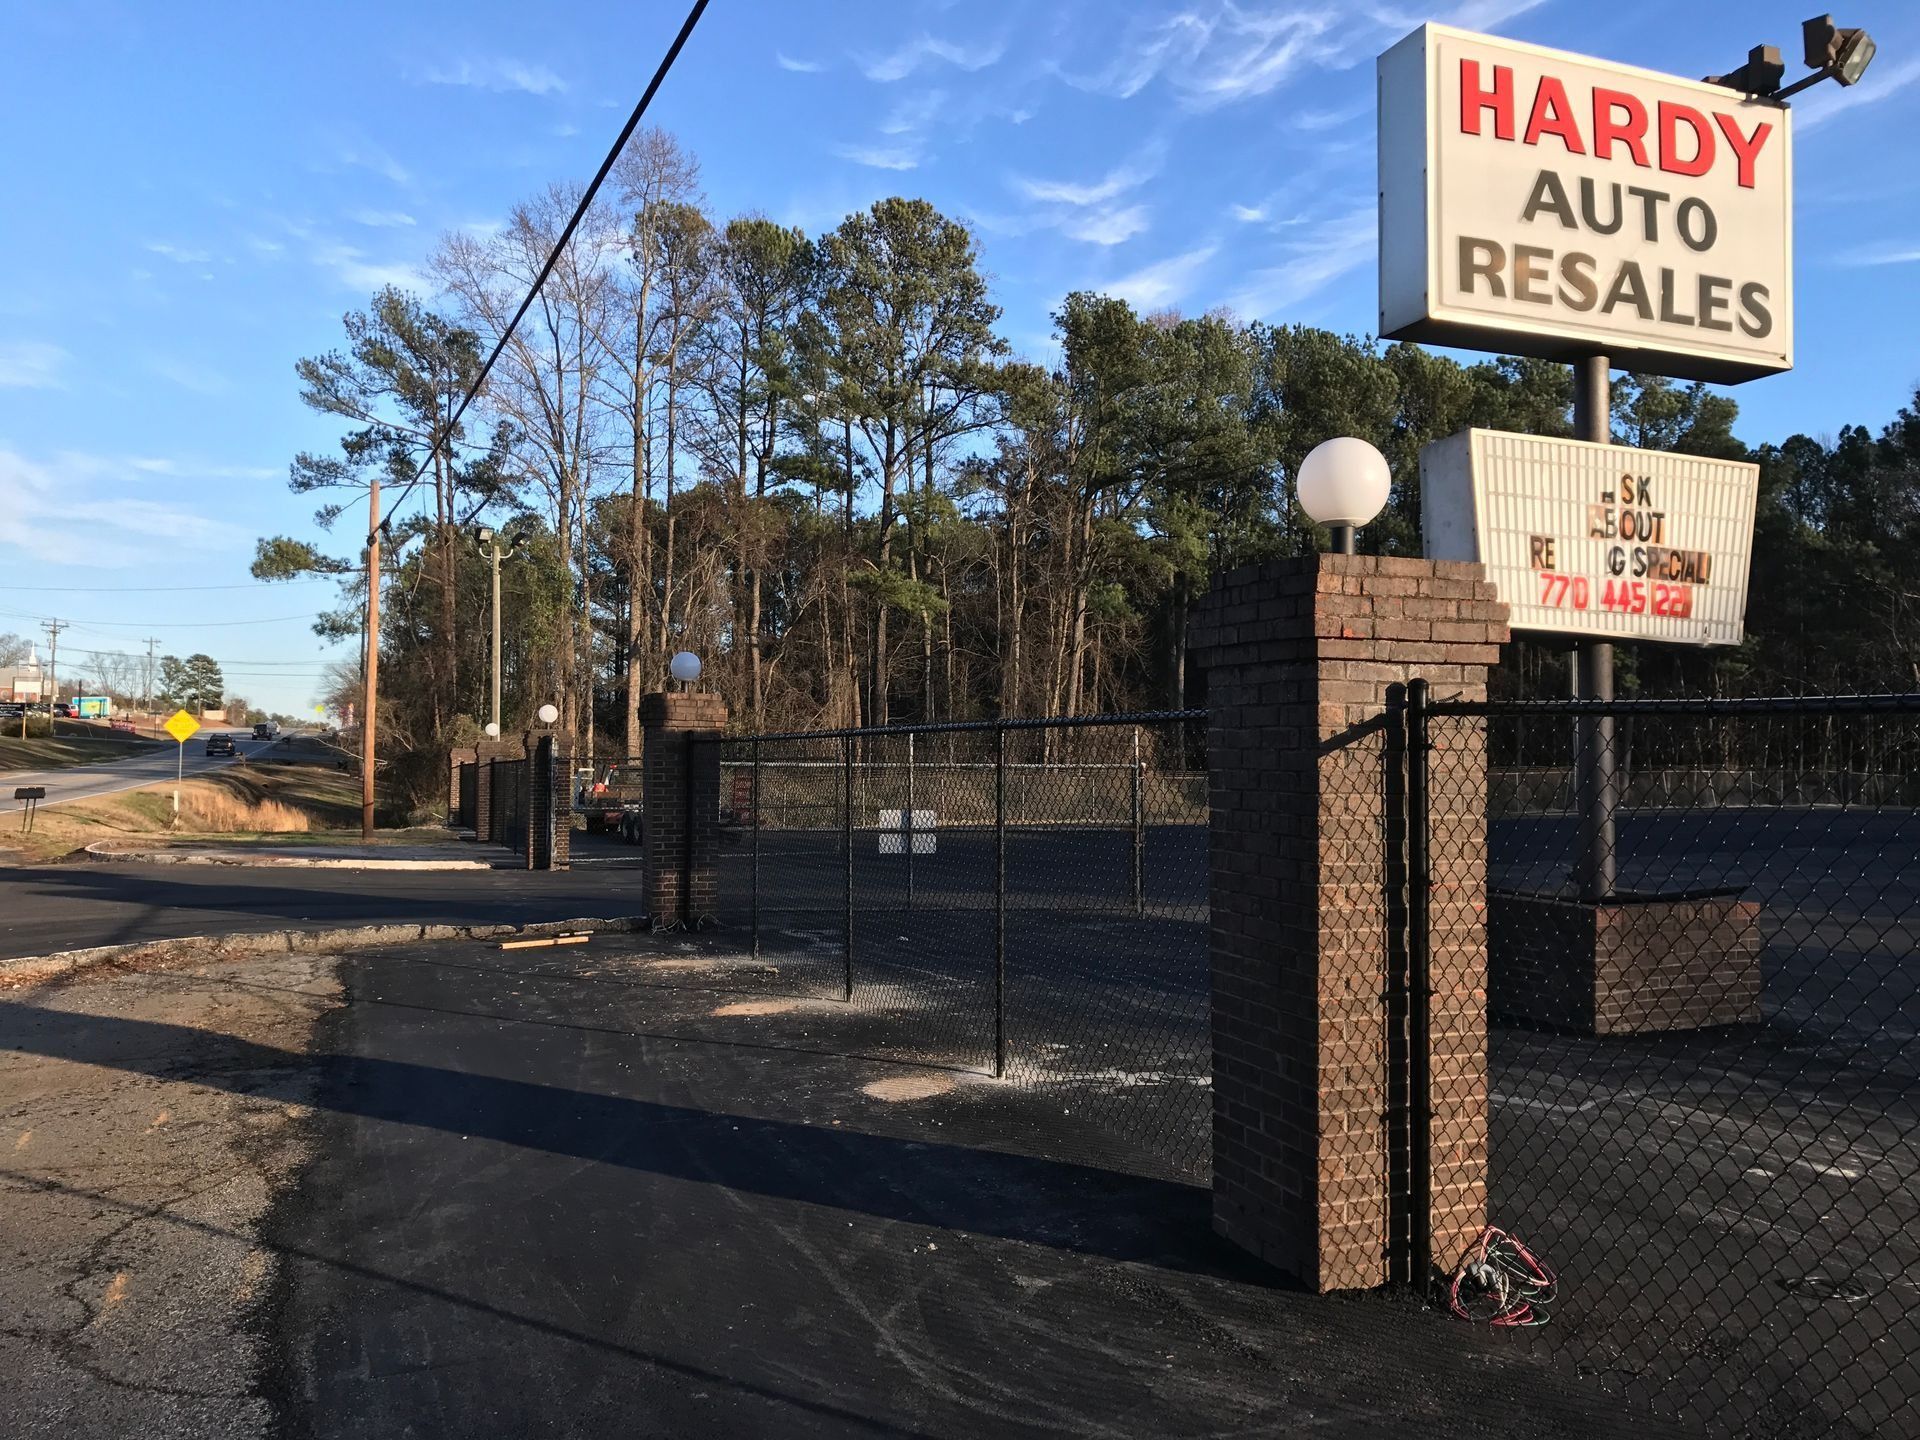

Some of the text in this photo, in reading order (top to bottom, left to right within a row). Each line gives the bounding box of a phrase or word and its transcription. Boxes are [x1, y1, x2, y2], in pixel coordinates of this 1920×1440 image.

[1460, 58, 1773, 189] HARDY
[1523, 169, 1717, 252] AUTO
[1458, 235, 1773, 339] RESALES
[1541, 573, 1589, 609] 770
[1602, 579, 1646, 614] 445
